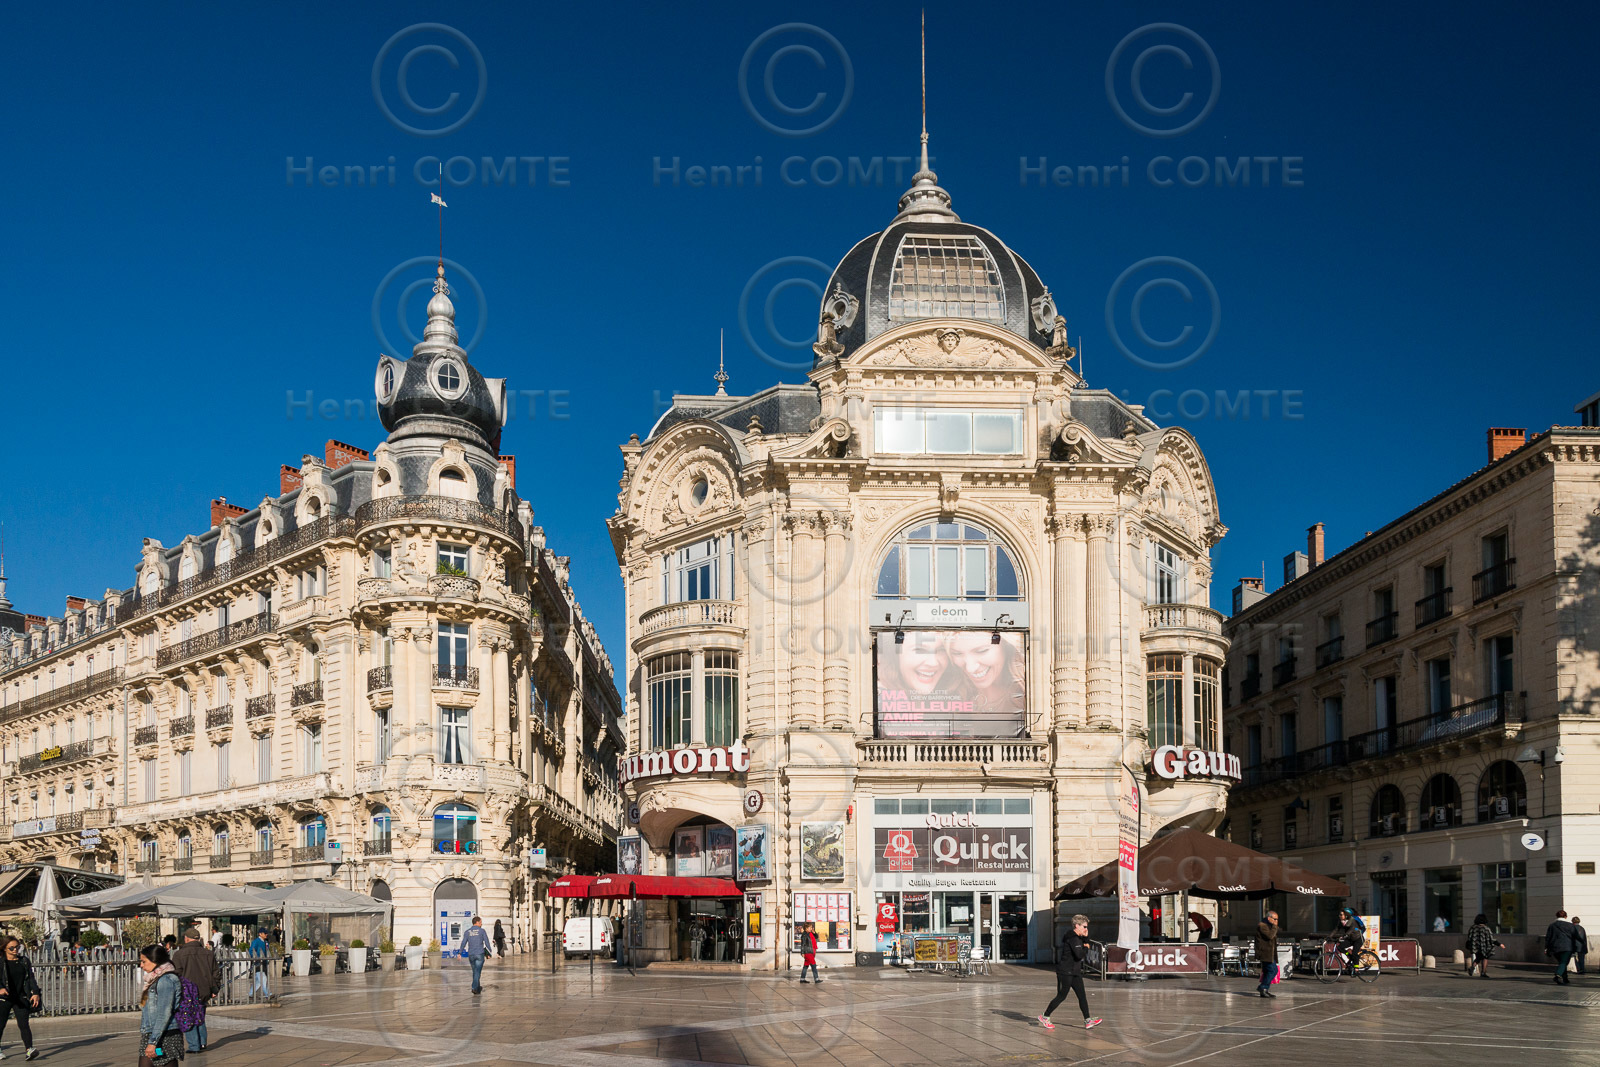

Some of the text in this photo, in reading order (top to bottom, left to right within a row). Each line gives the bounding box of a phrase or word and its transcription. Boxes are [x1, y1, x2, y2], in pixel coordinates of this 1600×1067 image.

[931, 605, 968, 616] eleom
[882, 690, 907, 700] MA
[882, 701, 973, 712] MEILLEURE
[883, 713, 924, 723] AMIE
[1153, 744, 1242, 780] Gaum
[926, 811, 979, 830] Quick
[439, 840, 477, 854] CIC
[933, 834, 1029, 865] Quick
[978, 861, 1030, 869] Restaurant
[908, 879, 932, 887] Quality
[936, 879, 957, 887] Burger
[1218, 884, 1247, 893] Quick
[1296, 885, 1325, 895] Quick
[1125, 949, 1188, 970] Quick
